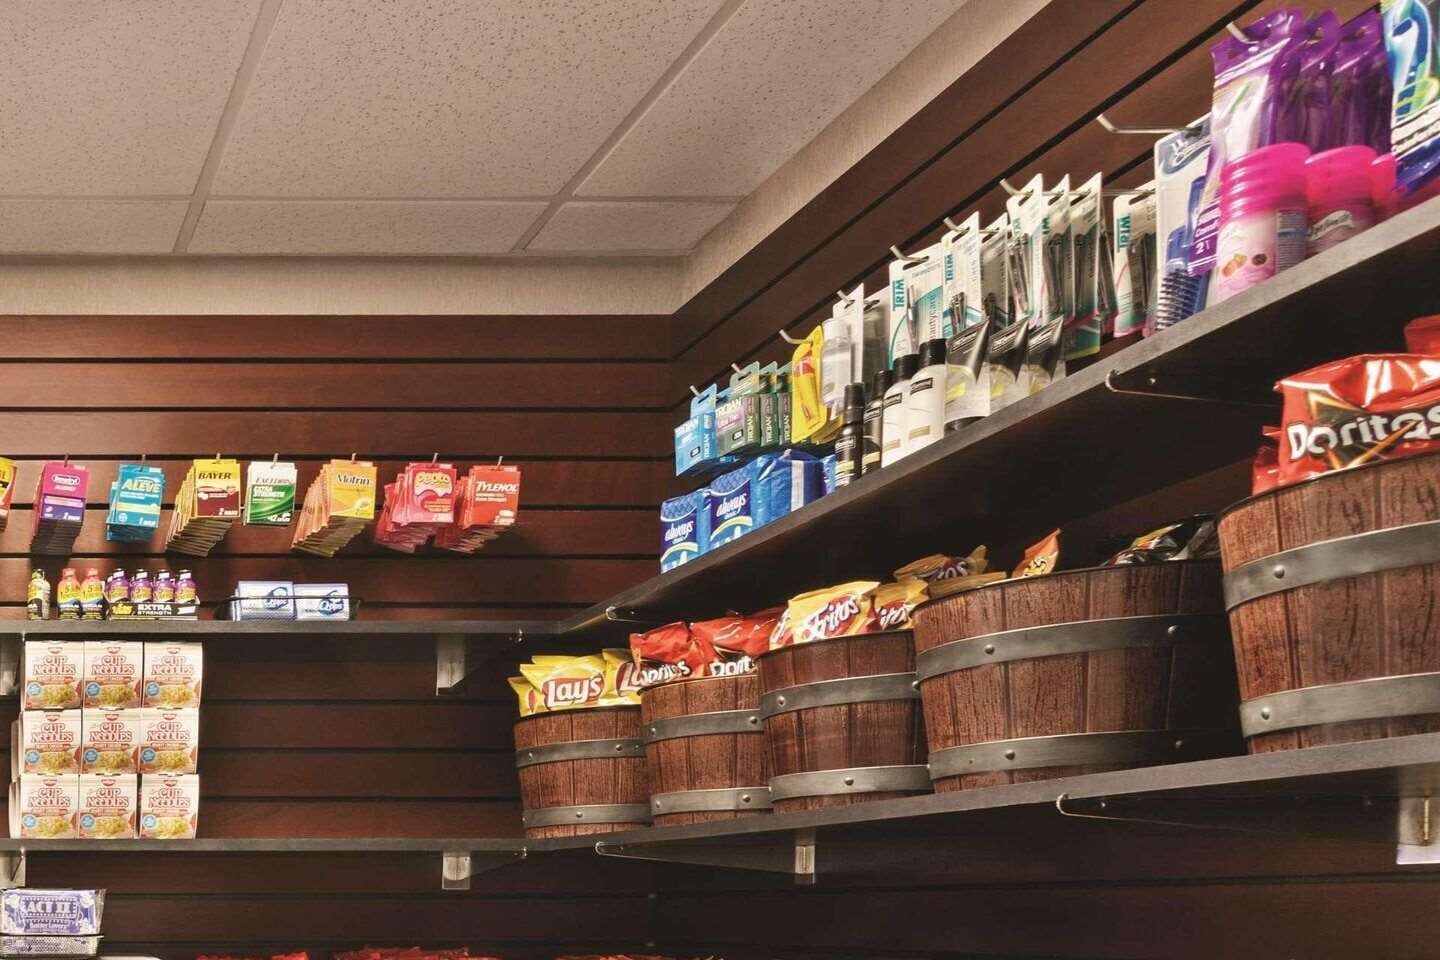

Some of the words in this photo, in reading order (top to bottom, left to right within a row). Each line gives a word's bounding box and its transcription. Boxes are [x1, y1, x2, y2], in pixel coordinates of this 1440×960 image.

[1118, 215, 1131, 249] TRIM
[894, 278, 905, 309] TRIM
[746, 414, 754, 442] TROJAN
[765, 415, 774, 443] TROJAN
[1287, 405, 1440, 461] Doritos
[198, 472, 231, 480] BAYER
[337, 474, 369, 485] Motrin
[121, 478, 161, 493] ALEVE
[475, 481, 519, 492] TYLENOL
[716, 493, 747, 517] always
[664, 520, 694, 542] always
[807, 594, 859, 640] Fritos
[43, 656, 67, 665] CUP
[101, 656, 127, 666] CUP
[161, 656, 185, 666] CUP
[546, 675, 603, 707] Lay's
[41, 723, 65, 733] CUP
[100, 722, 124, 732] CUP
[157, 722, 181, 732] CUP
[38, 788, 62, 798] CUP
[96, 788, 121, 798] CUP
[158, 788, 183, 798] CUP
[27, 901, 52, 913] ACT
[56, 901, 70, 913] II
